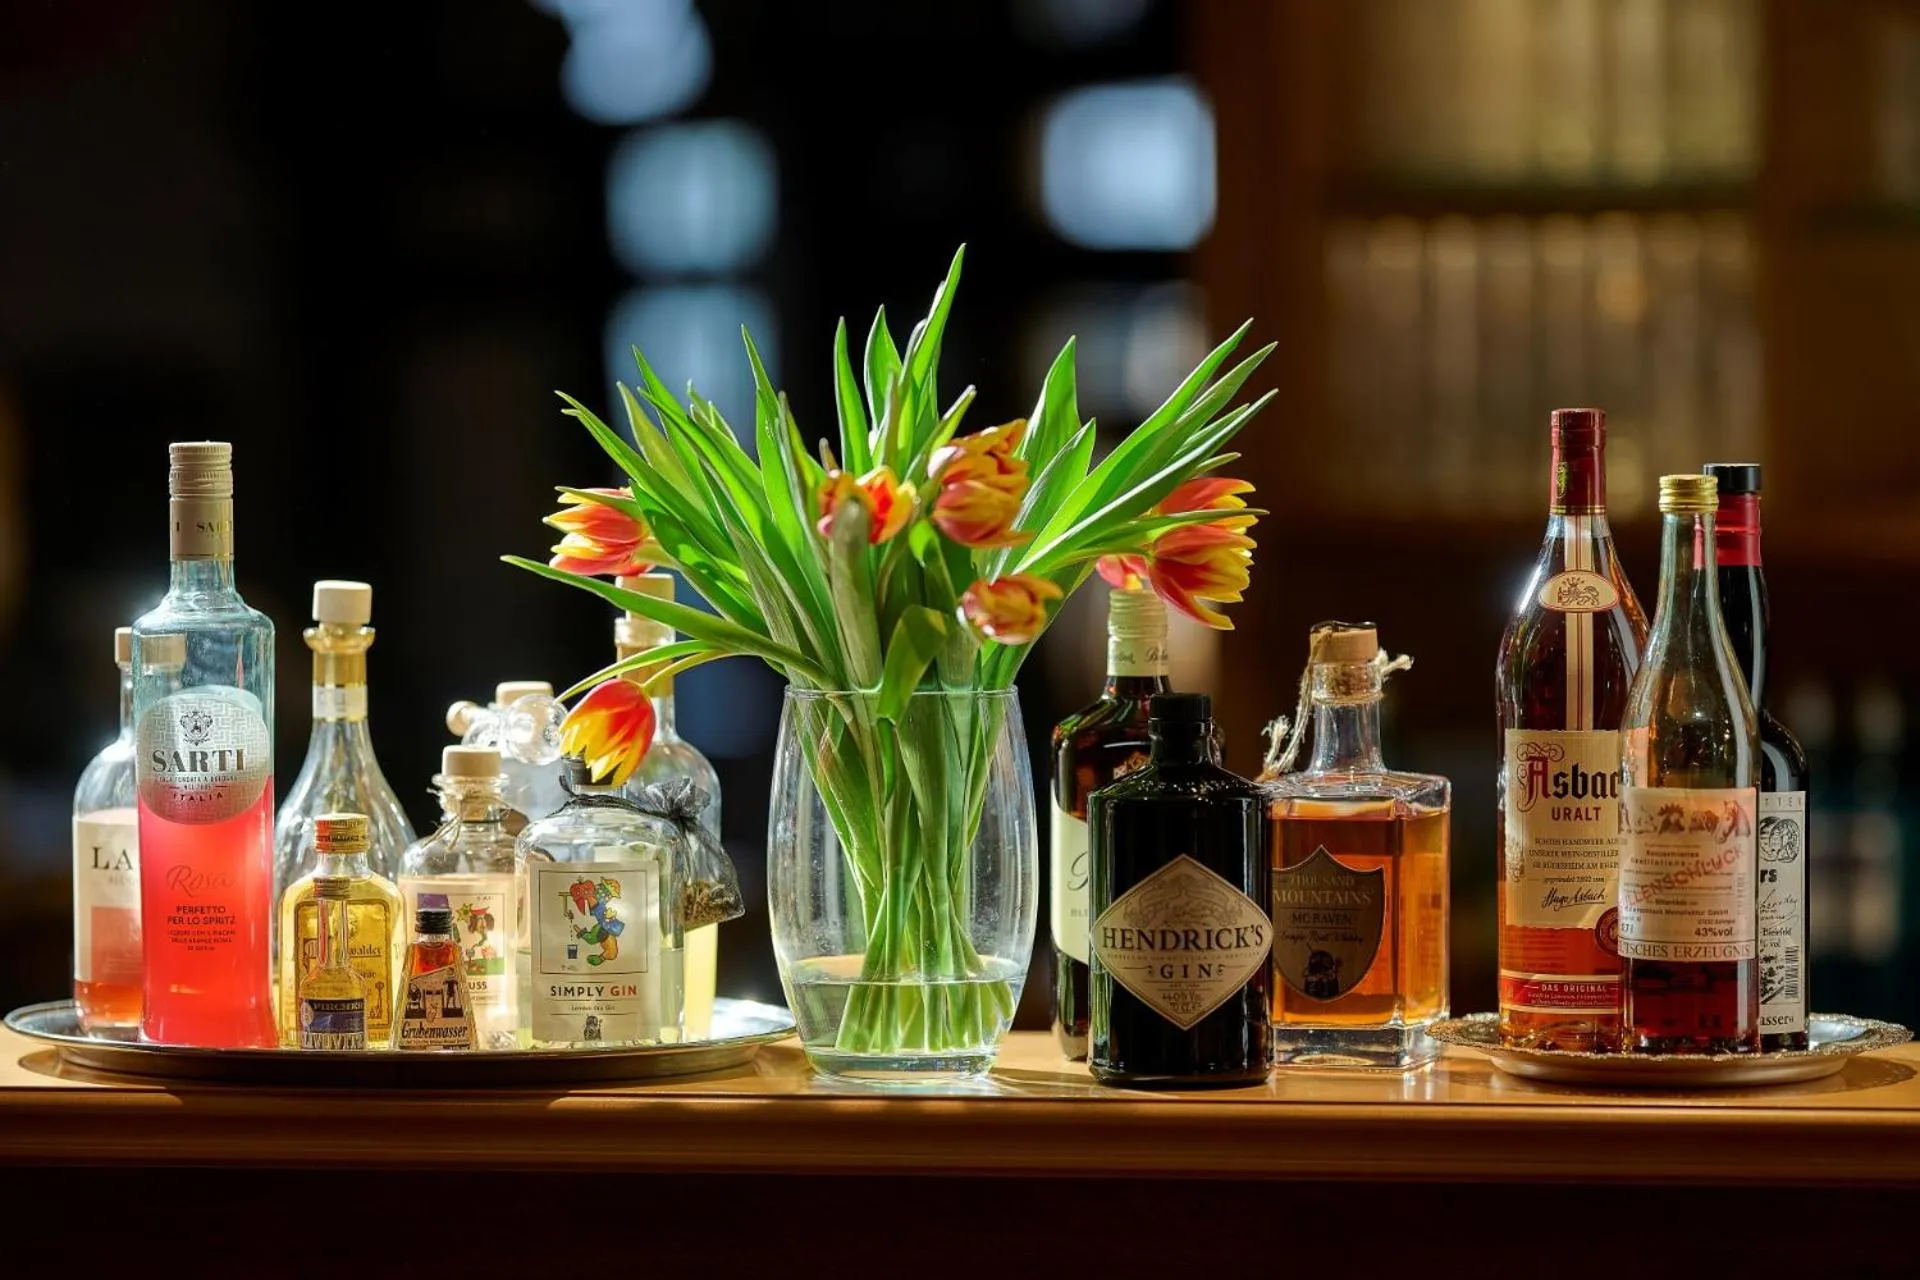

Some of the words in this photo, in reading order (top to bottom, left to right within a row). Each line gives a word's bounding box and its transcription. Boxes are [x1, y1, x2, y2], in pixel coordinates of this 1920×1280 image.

[153, 748, 245, 772] SARTI
[173, 791, 224, 801] ITALIA
[1551, 806, 1601, 821] URALT
[91, 846, 133, 871] LA
[166, 865, 235, 899] Rosa
[1290, 874, 1356, 887] THOUSAND
[1759, 868, 1777, 883] rs
[1272, 889, 1373, 905] MOUNTAINS
[176, 905, 226, 914] PERFETTO
[167, 916, 184, 925] PER
[187, 917, 201, 925] LO
[202, 916, 236, 925] SPRITZ
[1102, 924, 1264, 951] HENDRICK'S
[1618, 942, 1668, 957] TSCHES
[1674, 945, 1752, 957] ERZEUGNIS
[1160, 963, 1212, 979] GIN
[468, 981, 487, 990] USS
[550, 985, 604, 997] SIMPLY
[609, 985, 638, 997] GIN
[1541, 984, 1558, 992] DAS
[1563, 984, 1607, 992] ORIGINAL
[401, 1020, 468, 1039] Grubenwasser
